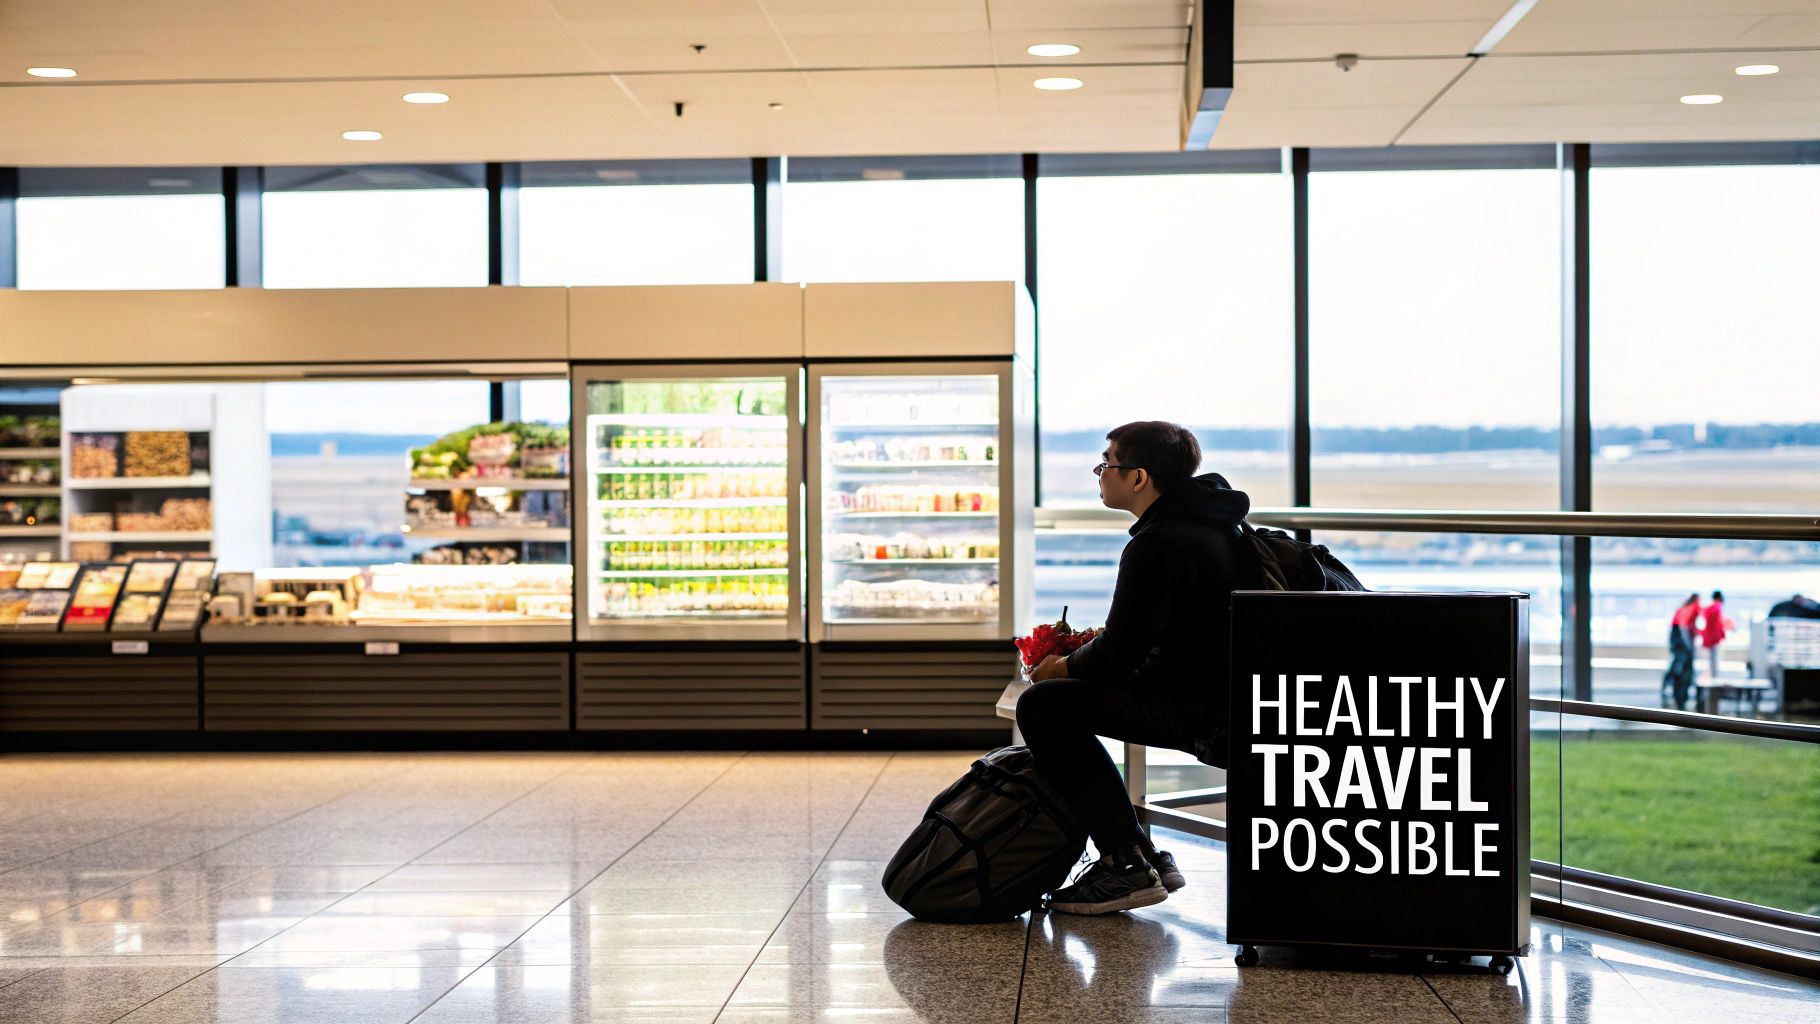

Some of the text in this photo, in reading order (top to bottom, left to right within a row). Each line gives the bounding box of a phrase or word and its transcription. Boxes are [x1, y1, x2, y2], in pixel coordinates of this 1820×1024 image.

[1252, 674, 1506, 739] HEALTHY
[1251, 744, 1489, 811] TRAVEL
[1252, 818, 1501, 877] POSSIBLE
